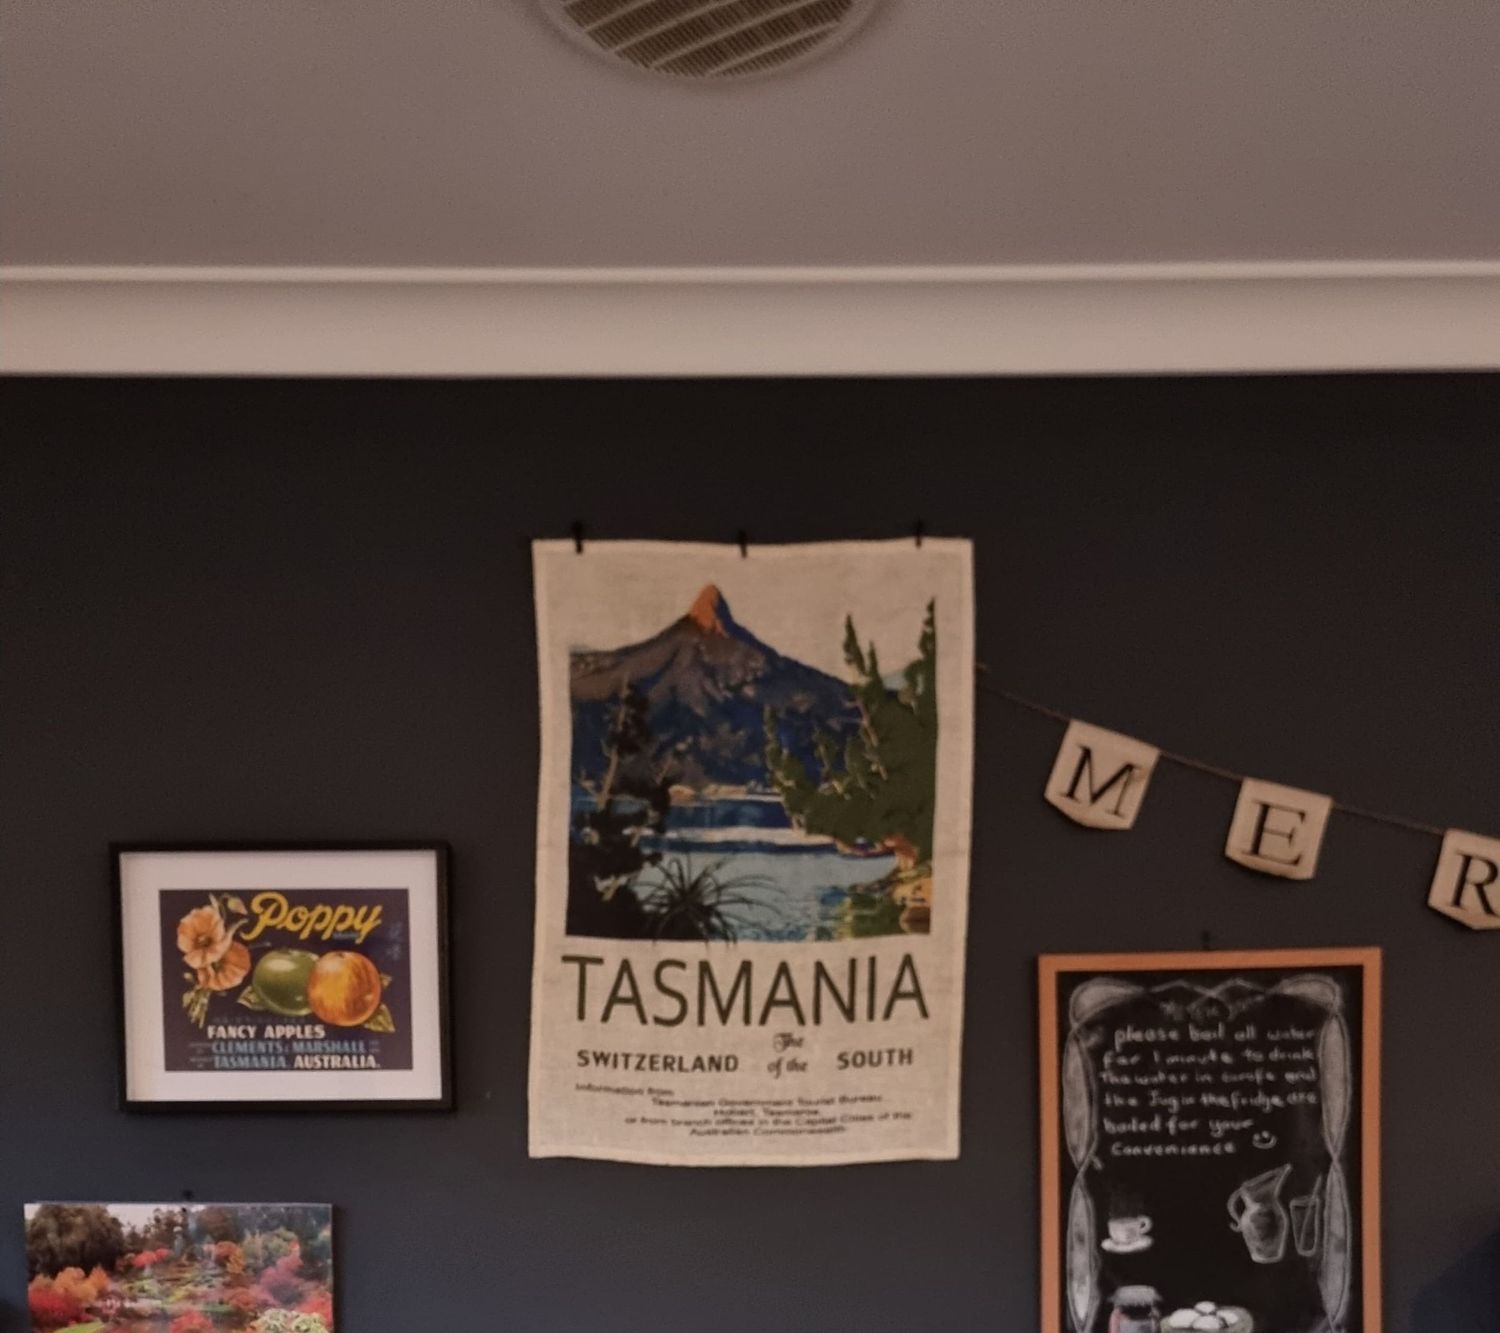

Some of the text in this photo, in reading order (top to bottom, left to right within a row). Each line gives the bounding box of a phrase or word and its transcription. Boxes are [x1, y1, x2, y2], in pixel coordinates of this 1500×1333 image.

[1063, 744, 1141, 819] M
[1241, 802, 1306, 866] E
[240, 891, 383, 945] Poppy
[561, 954, 930, 1026] TASMANIA
[207, 1024, 326, 1039] FANCY APPLES
[773, 1032, 804, 1052] The
[1114, 1024, 1179, 1052] please
[1234, 1023, 1255, 1041] all
[577, 1047, 914, 1080] SWITZERLAND of the SOUTH
[1243, 1048, 1263, 1063] to
[1284, 1067, 1316, 1085] and
[1165, 1114, 1198, 1136] for
